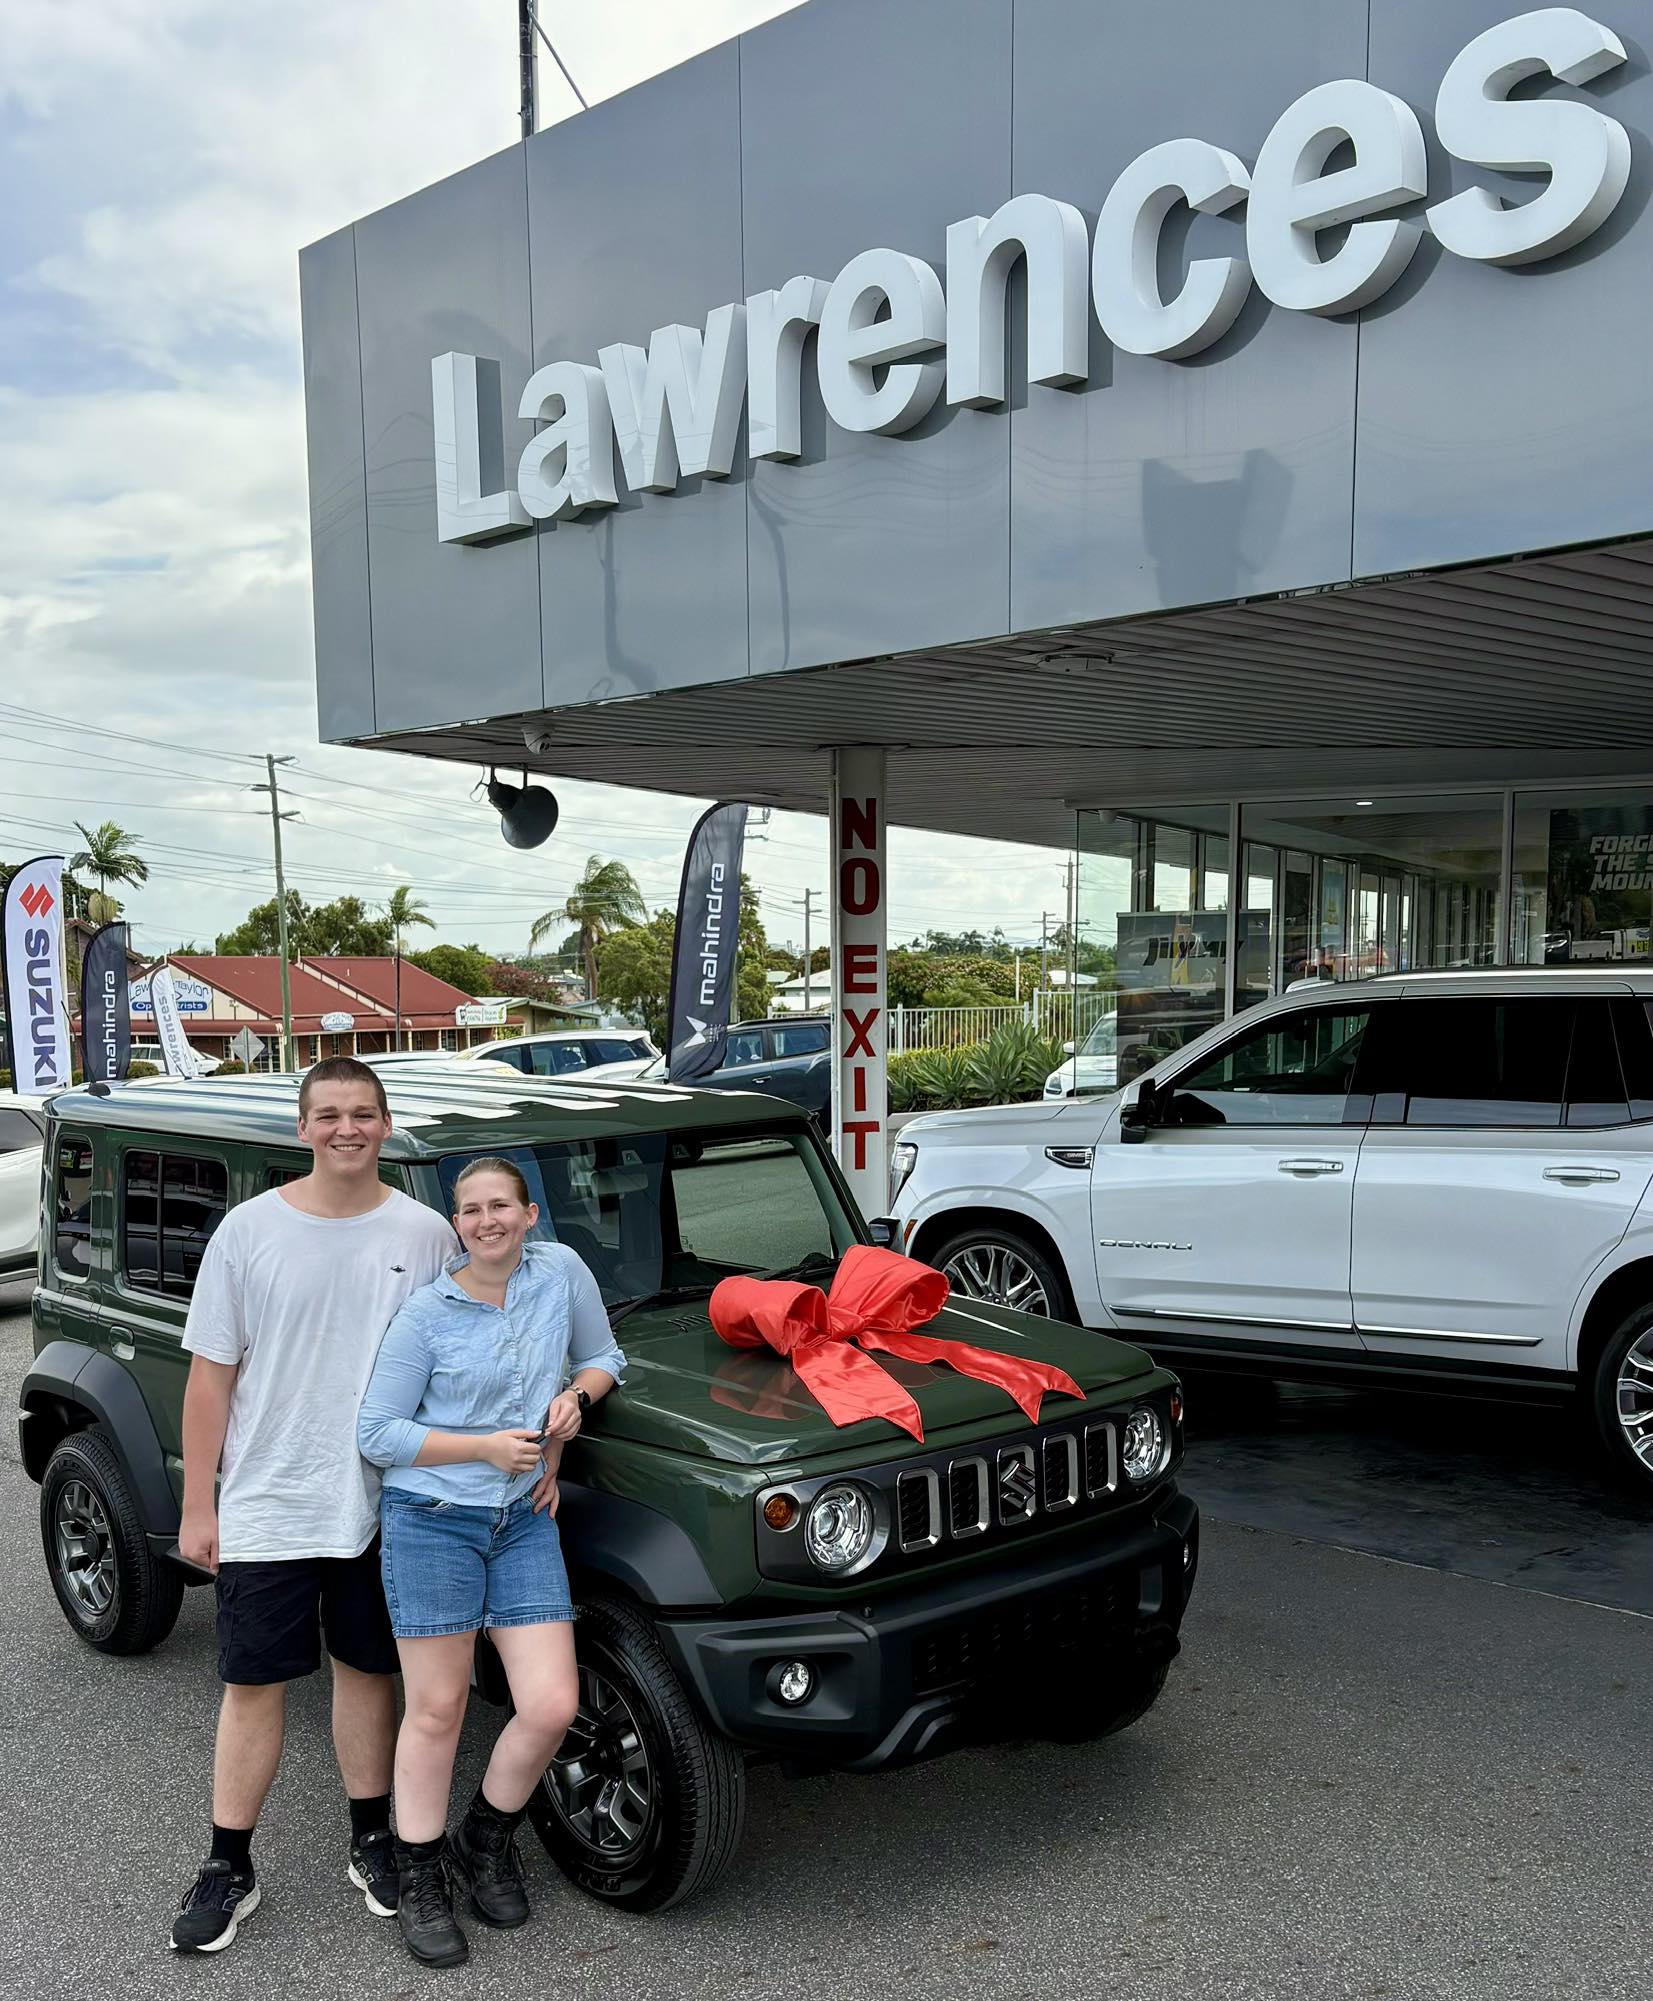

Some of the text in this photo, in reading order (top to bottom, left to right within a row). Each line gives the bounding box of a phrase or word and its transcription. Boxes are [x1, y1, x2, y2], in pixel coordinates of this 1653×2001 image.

[432, 7, 1631, 546] Lawrences
[1594, 854, 1636, 872] THE
[700, 862, 725, 1005] mahindra
[840, 797, 880, 1170] NO EXIT
[24, 928, 58, 1087] SUZUKI
[102, 970, 117, 1078] mahindra
[136, 1002, 204, 1011] Optrists
[1100, 1239, 1192, 1250] DENALI
